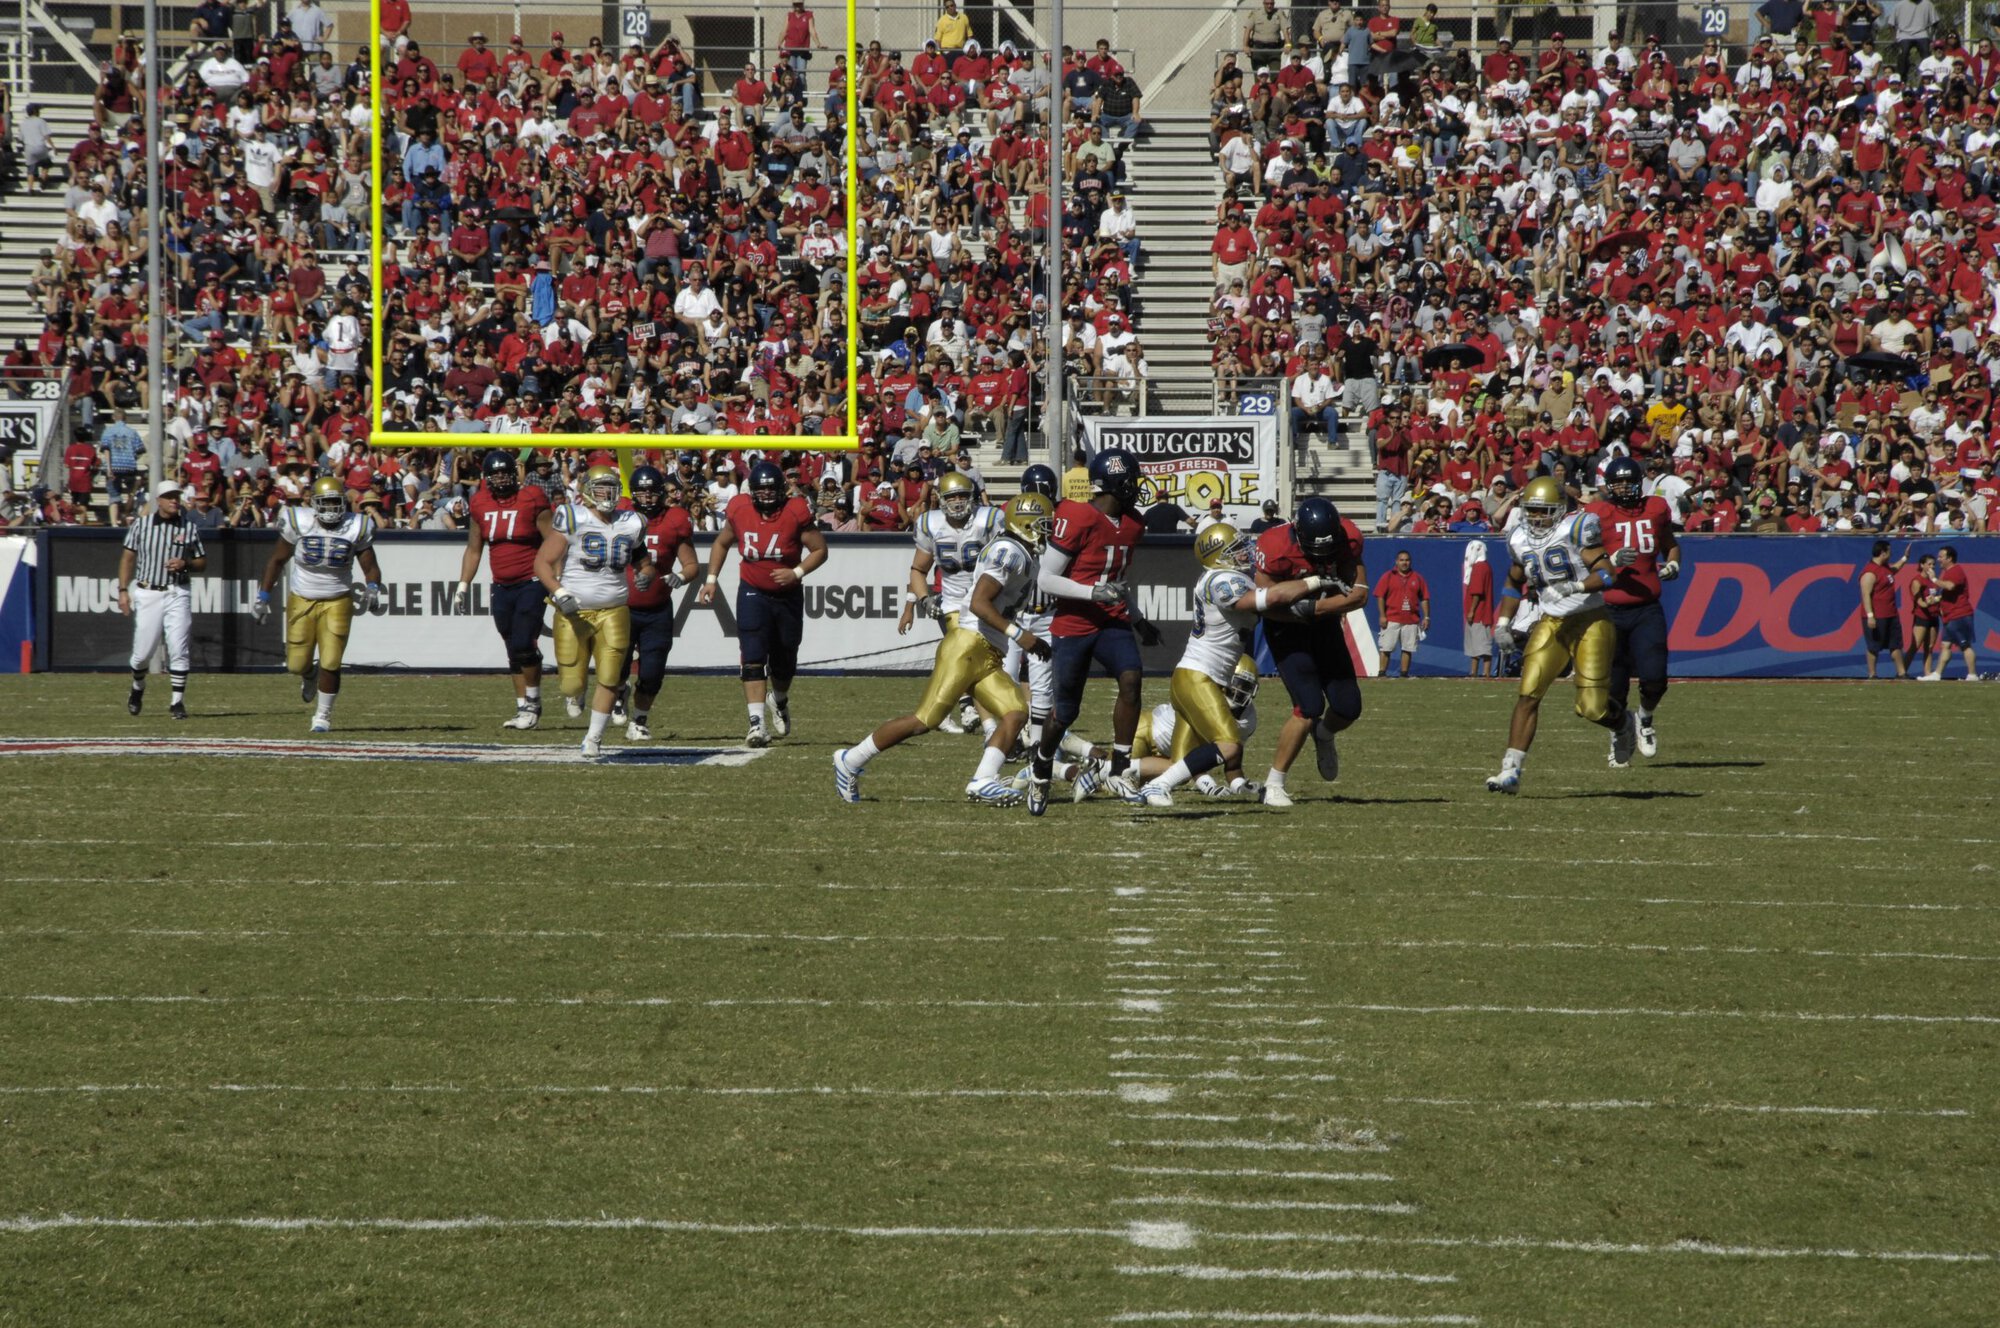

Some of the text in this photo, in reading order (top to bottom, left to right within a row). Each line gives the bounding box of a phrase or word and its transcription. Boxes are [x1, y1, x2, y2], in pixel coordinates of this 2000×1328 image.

[626, 11, 648, 35] 28
[1704, 9, 1726, 32] 29
[31, 381, 60, 399] 28
[1243, 396, 1272, 413] 29
[1179, 460, 1217, 470] FRESH
[484, 510, 518, 541] 77
[1615, 519, 1655, 554] 76
[301, 536, 353, 567] 92
[580, 531, 633, 573] 90
[743, 531, 783, 562] 64
[1096, 546, 1128, 586] 11
